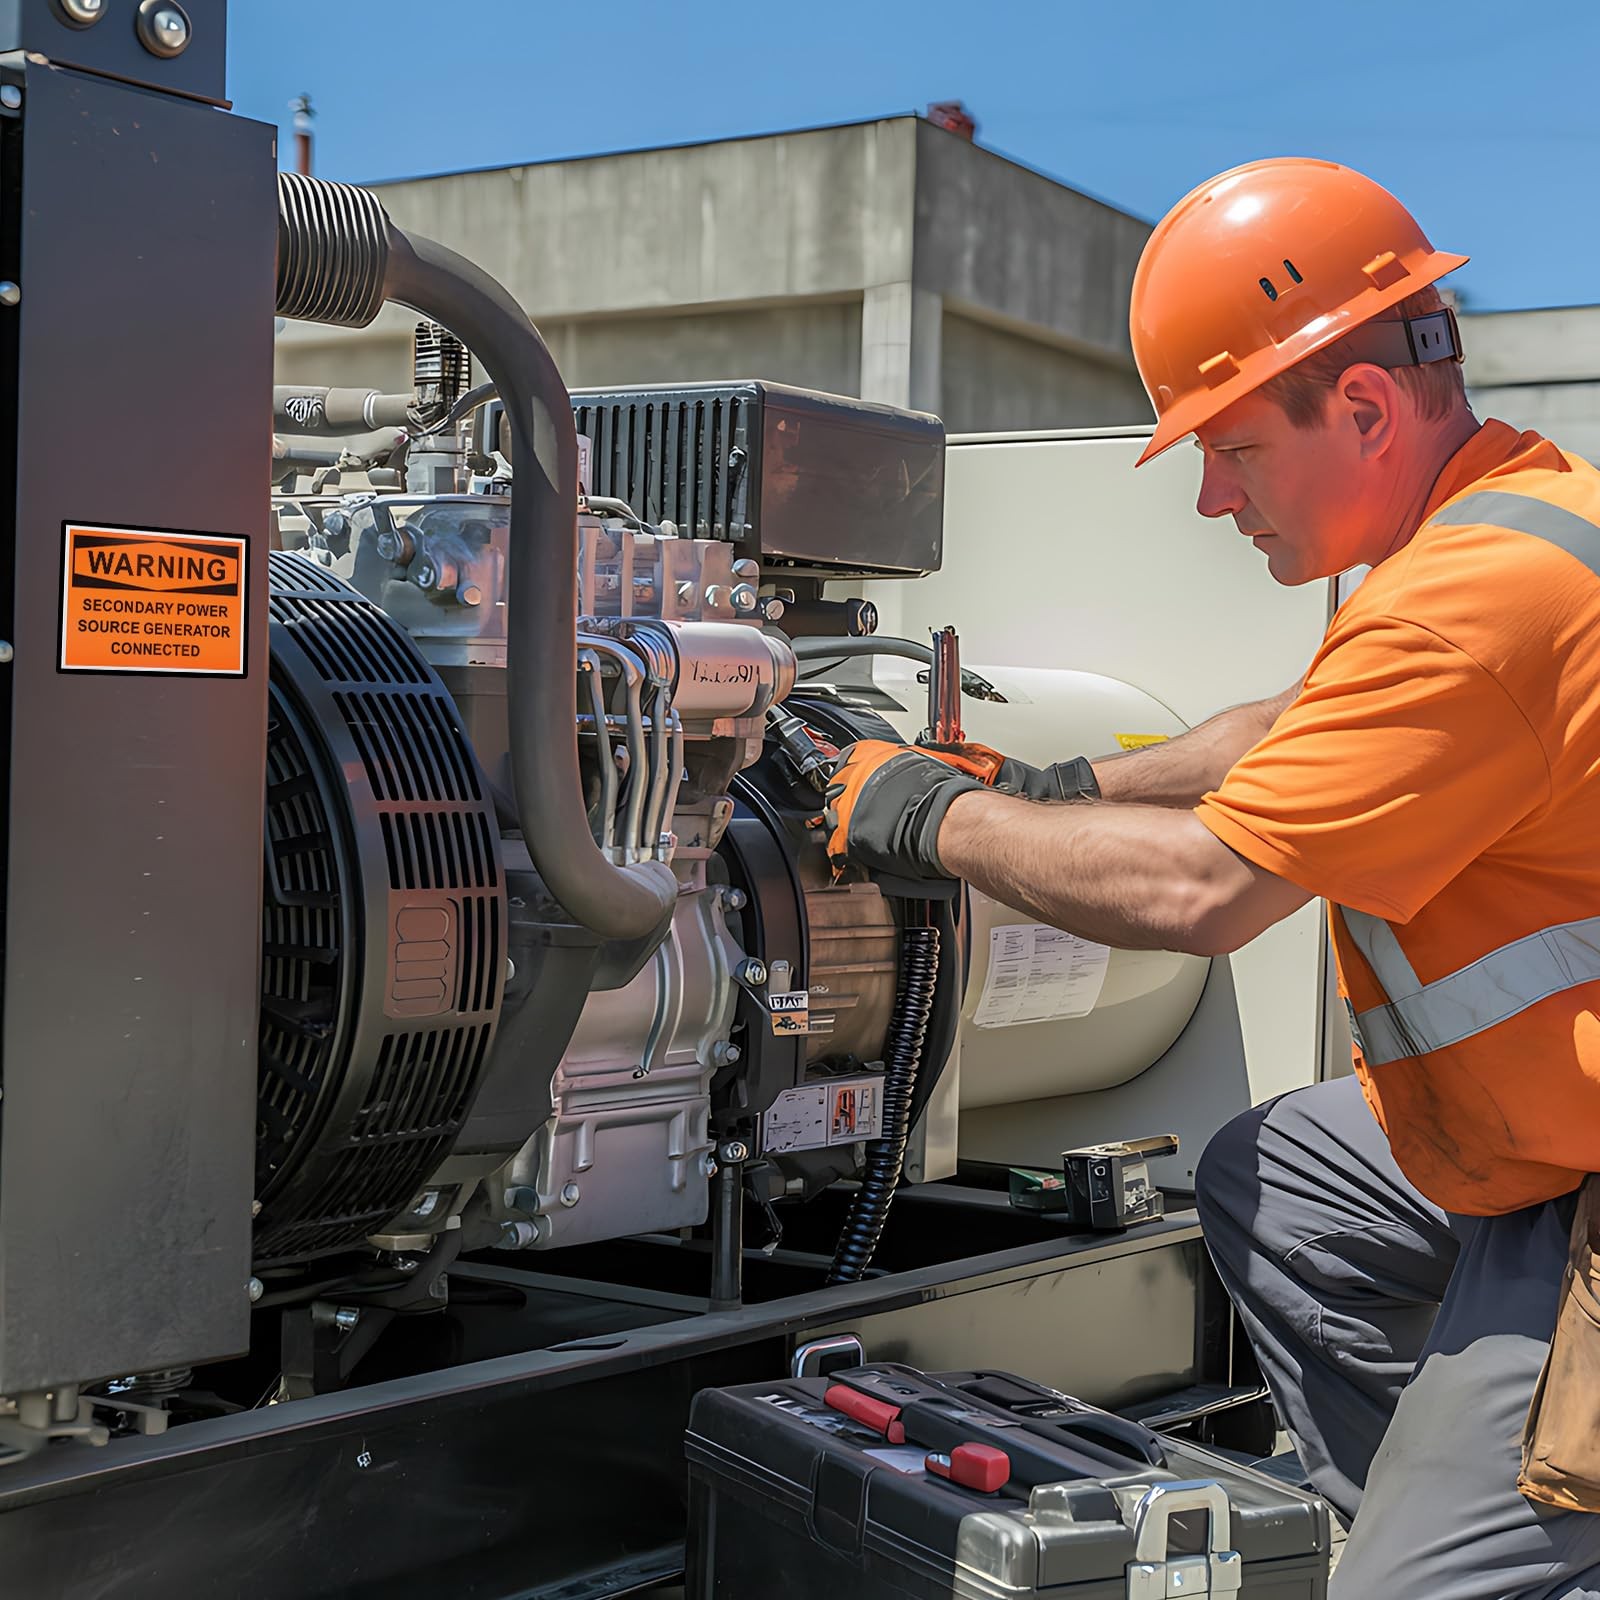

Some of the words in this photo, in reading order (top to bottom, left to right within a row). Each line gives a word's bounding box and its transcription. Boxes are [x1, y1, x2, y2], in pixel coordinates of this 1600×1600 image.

[88, 550, 226, 581] WARNING
[83, 598, 174, 615] SECONDARY
[177, 603, 228, 618] POWER
[78, 619, 140, 634] SOURCE
[143, 622, 231, 638] GENERATOR
[111, 641, 200, 657] CONNECTED
